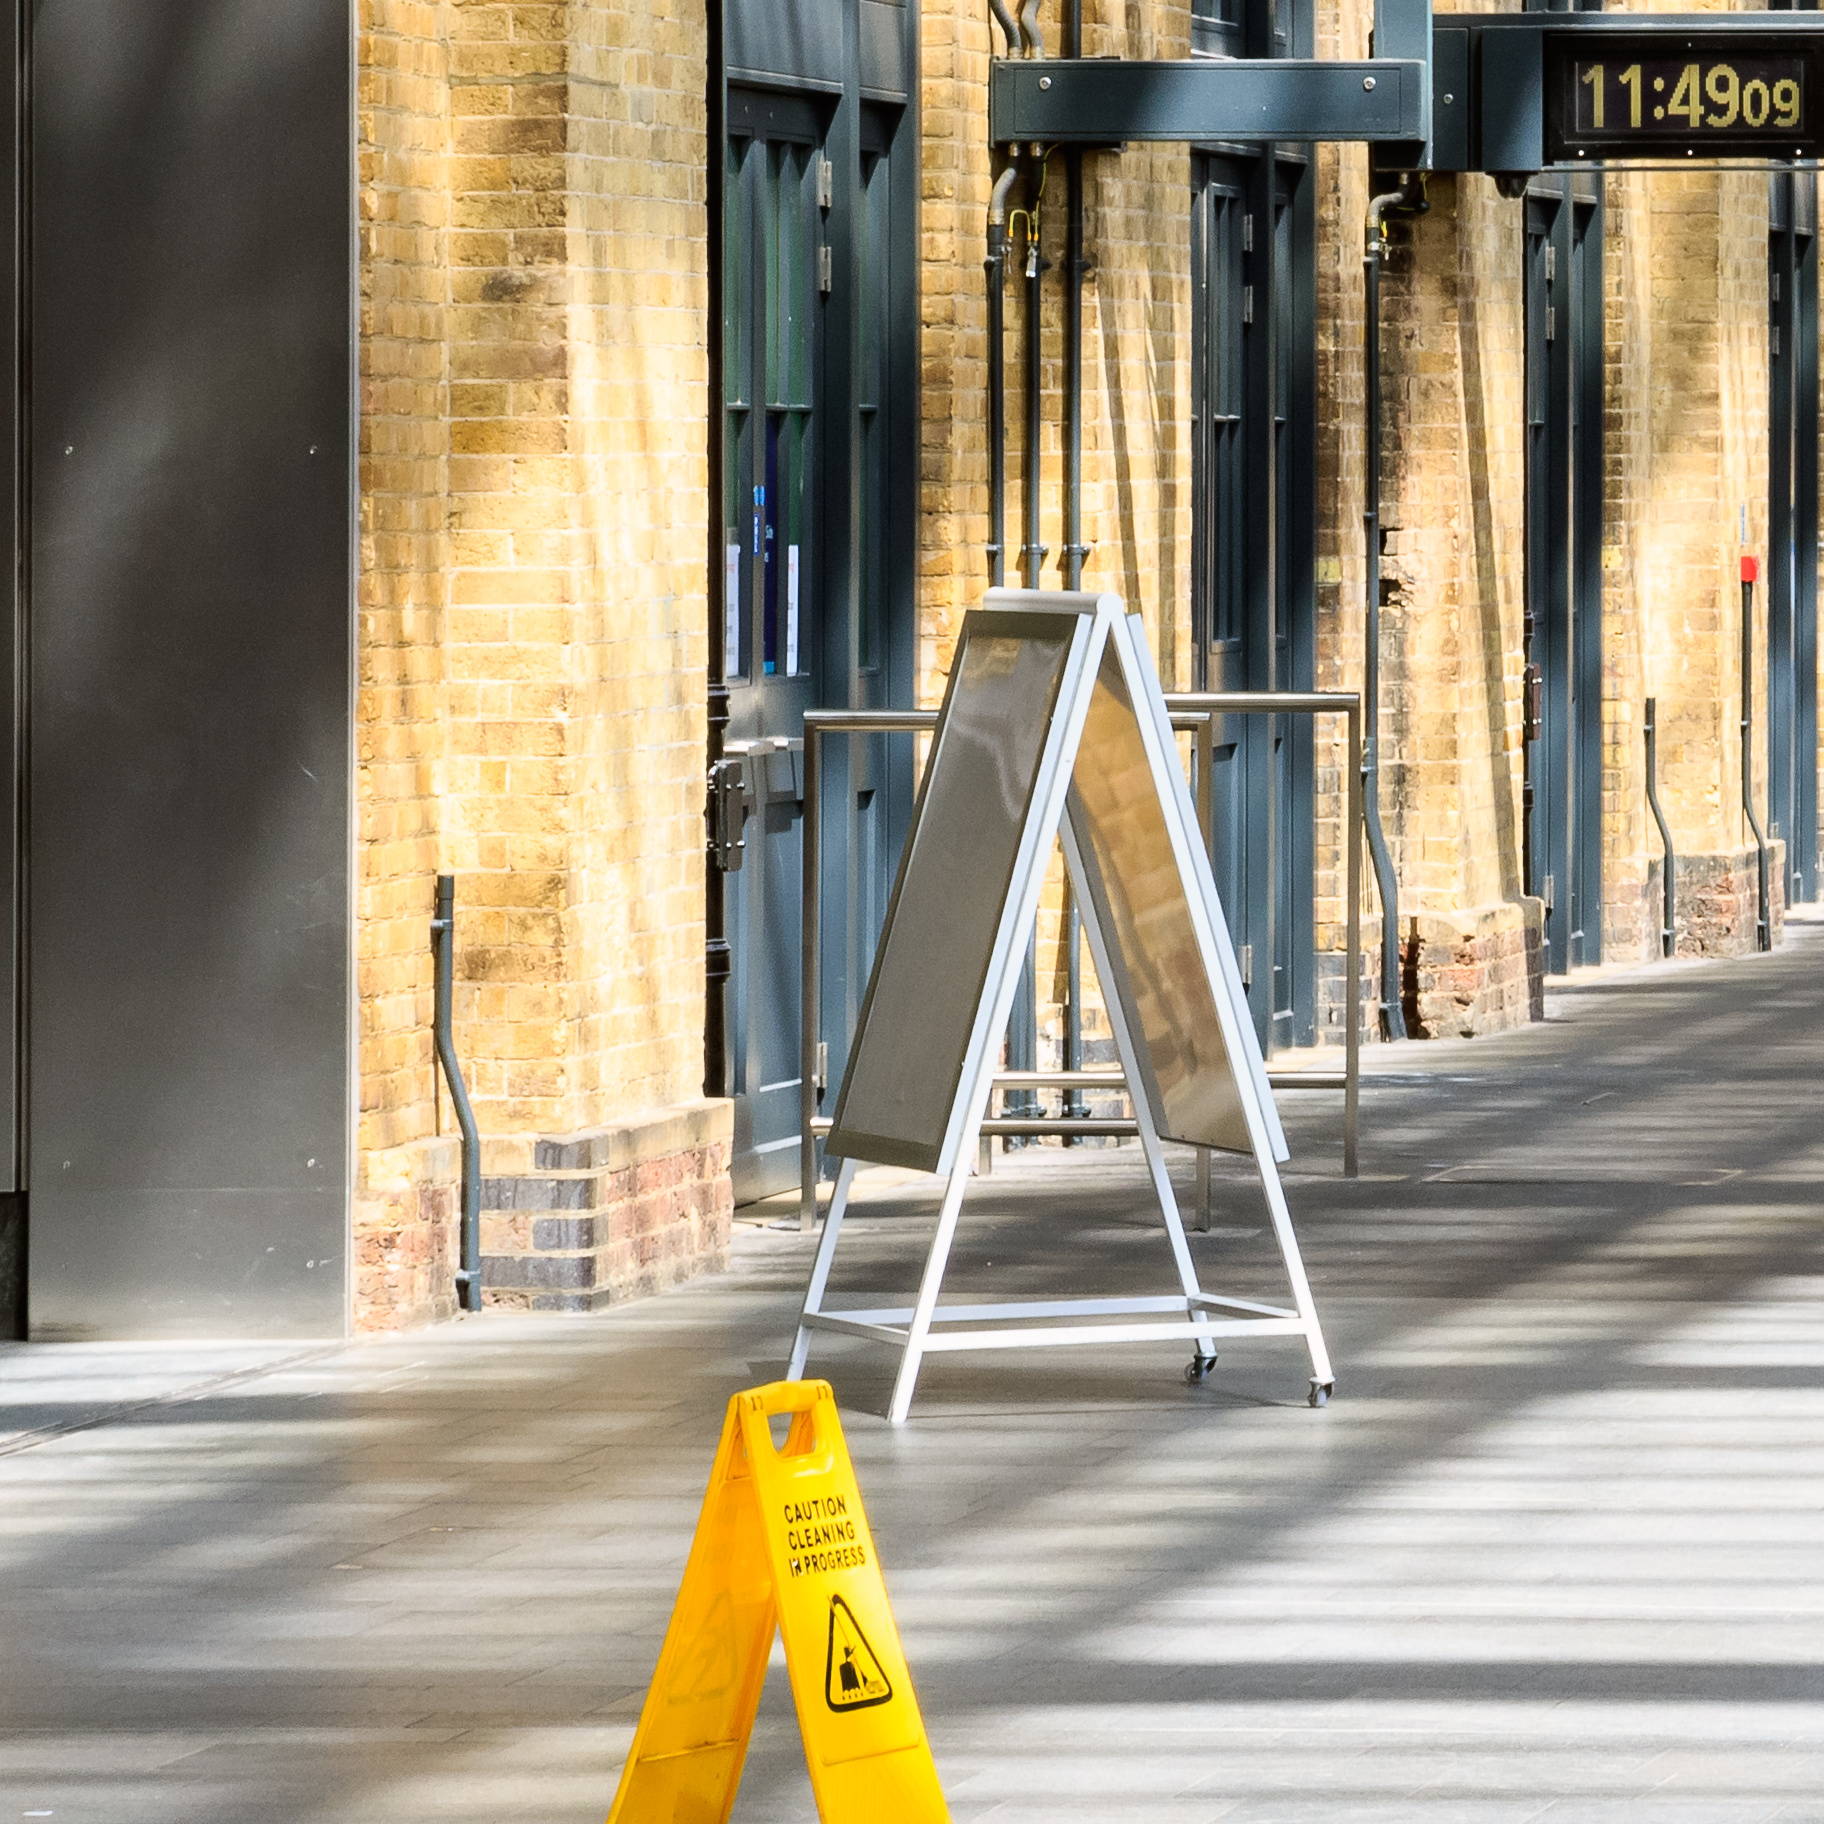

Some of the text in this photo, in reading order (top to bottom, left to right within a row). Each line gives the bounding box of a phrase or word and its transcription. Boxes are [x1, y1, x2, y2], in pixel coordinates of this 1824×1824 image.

[784, 1495, 847, 1524] CAUTION
[788, 1521, 855, 1550] CLEANING
[788, 1545, 866, 1578] IN PROGRESS
